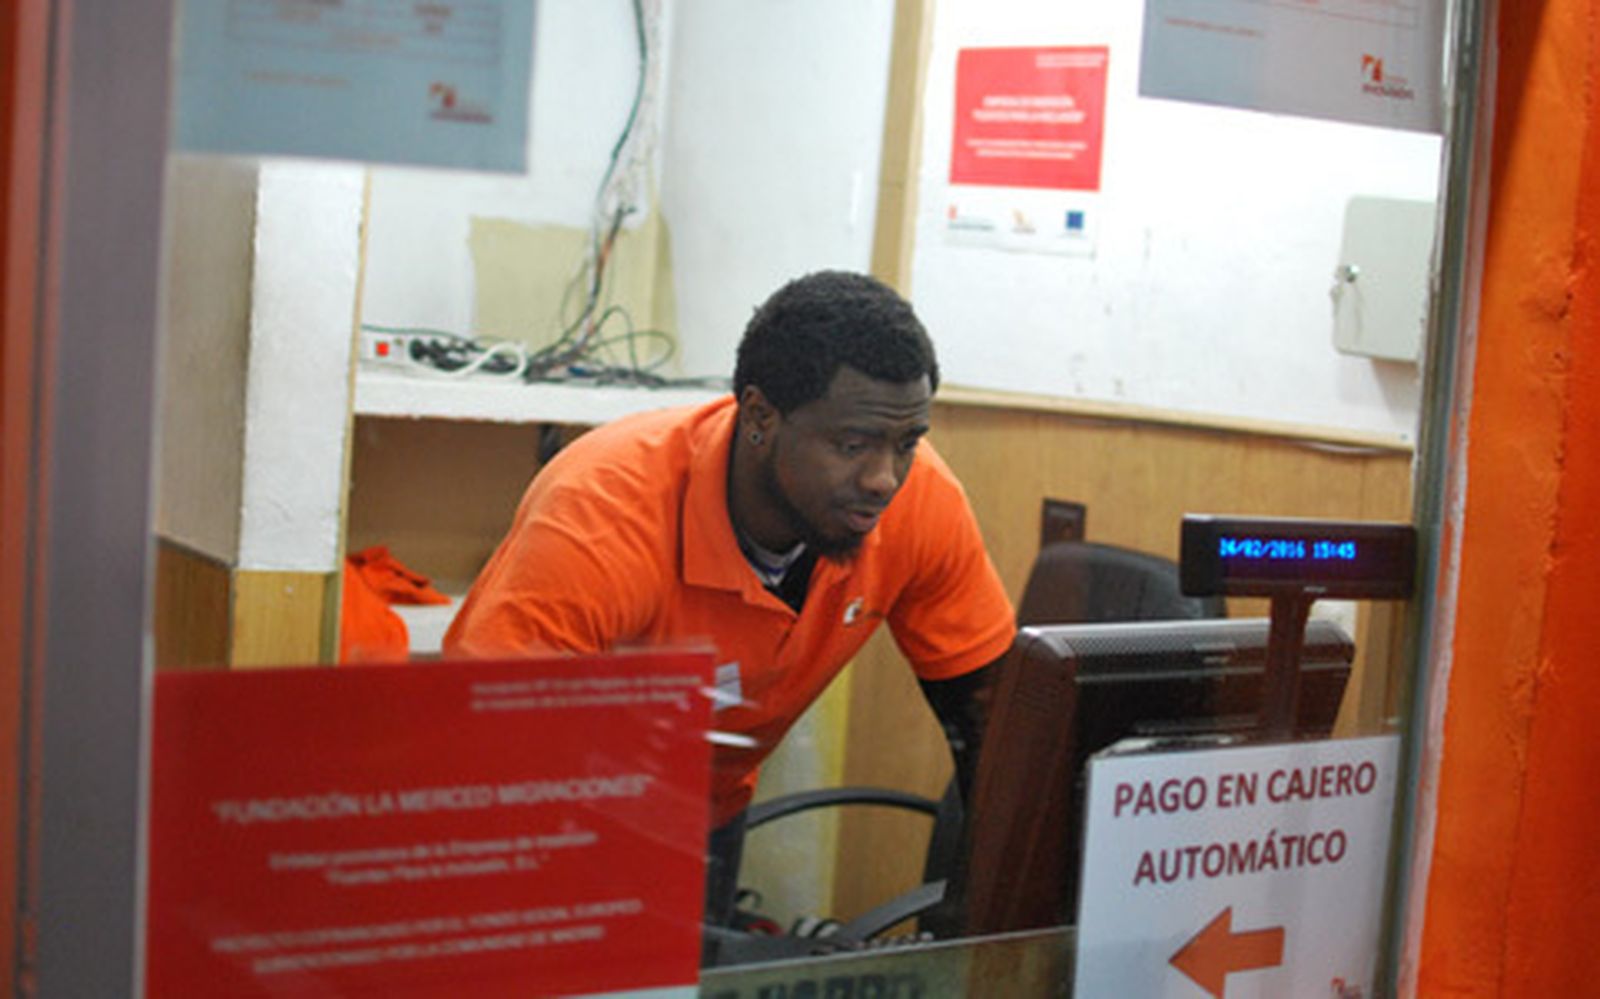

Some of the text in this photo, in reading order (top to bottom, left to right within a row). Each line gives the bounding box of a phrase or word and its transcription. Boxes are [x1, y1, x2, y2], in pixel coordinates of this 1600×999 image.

[1313, 541, 1355, 559] 15:45
[365, 792, 394, 816] LA
[399, 786, 492, 812] MERCED
[1113, 761, 1376, 818] PAGO EN CAJERO
[1132, 828, 1347, 886] AUTOMÁTICO
